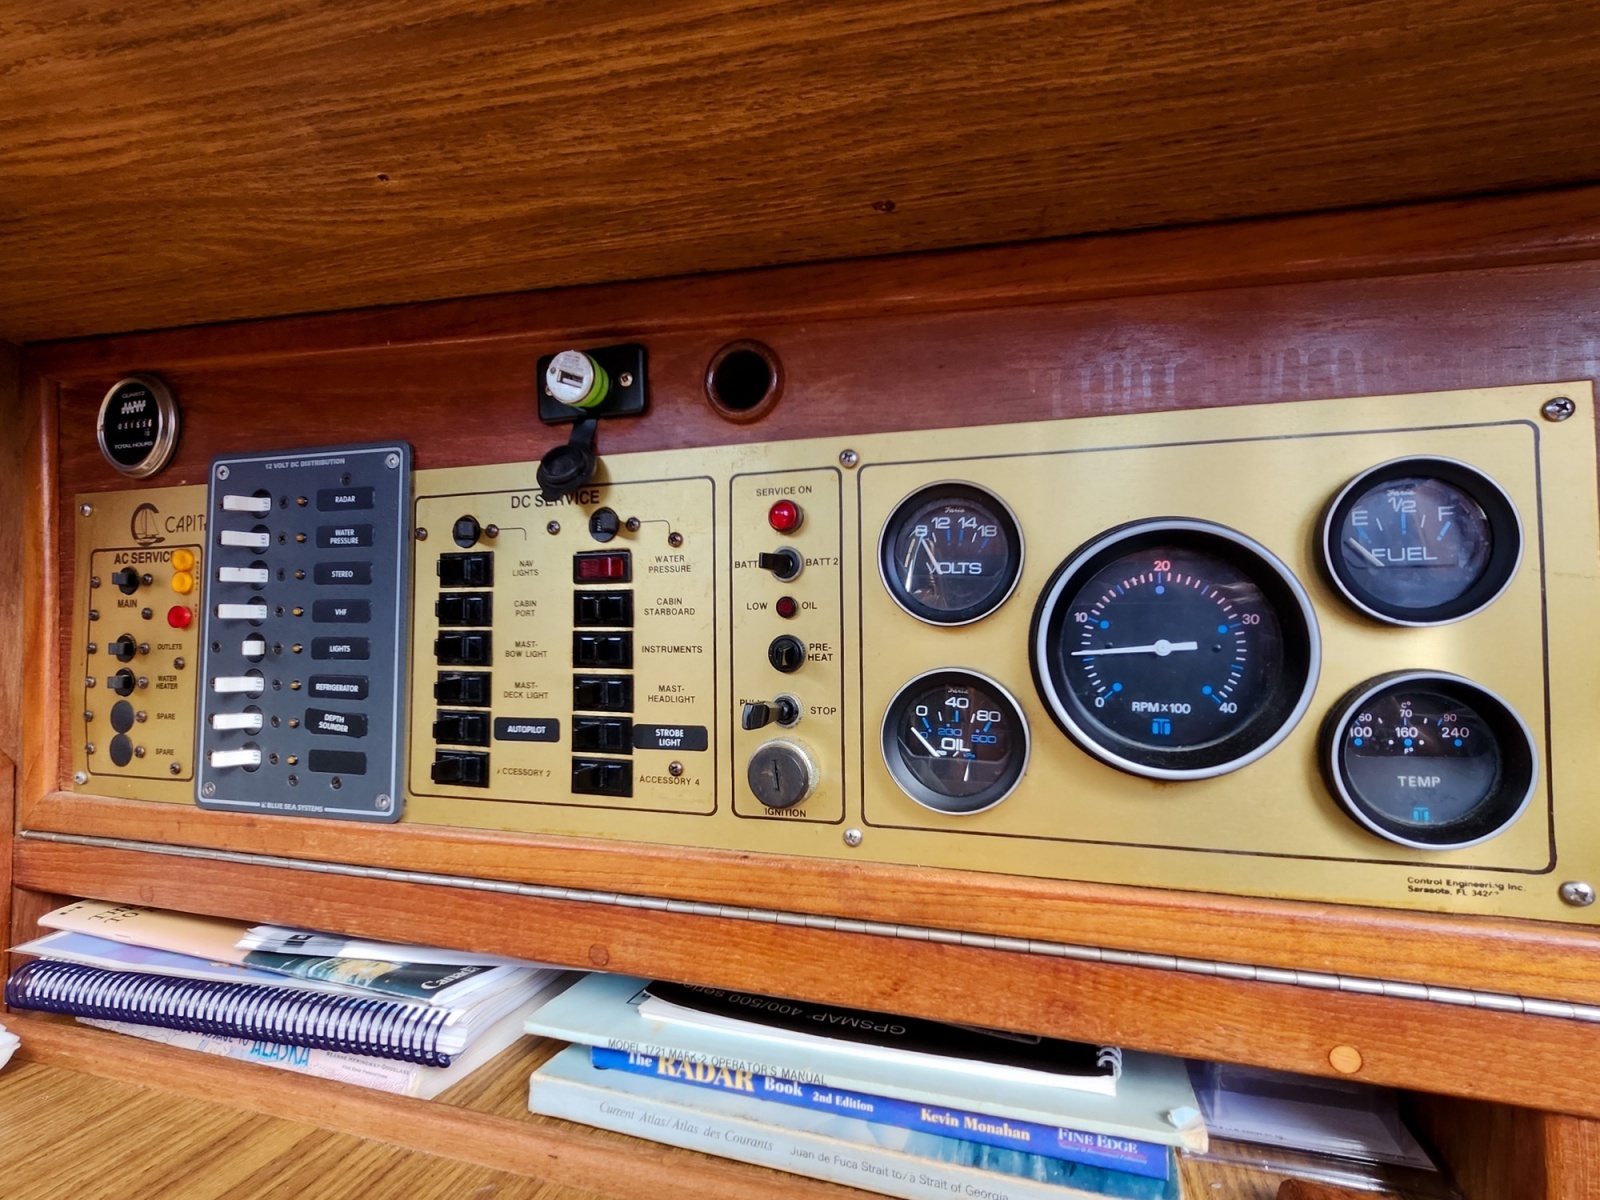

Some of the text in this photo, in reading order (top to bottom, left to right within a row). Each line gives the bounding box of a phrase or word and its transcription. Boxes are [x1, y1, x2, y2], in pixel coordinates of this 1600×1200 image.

[300, 458, 345, 467] DISTRIBUTION
[756, 485, 812, 497] SERVICE ON
[335, 495, 356, 503] RADAR
[511, 495, 531, 508] DC
[1351, 510, 1369, 526] E
[1438, 506, 1455, 521] F
[165, 514, 207, 533] CAPIT
[931, 517, 951, 529] 12
[957, 516, 978, 529] 14
[915, 525, 929, 537] 8
[977, 525, 998, 537] 18
[114, 551, 174, 564] AC SERVIC
[655, 555, 685, 564] WATER
[1371, 547, 1438, 562] FUEL
[805, 557, 839, 567] BATT 2
[1153, 560, 1171, 572] 20
[513, 569, 539, 577] LIGHTS
[649, 565, 692, 573] PRESSURE
[926, 562, 982, 575] VOLTS
[331, 570, 354, 578] STEREO
[117, 600, 138, 608] MAIN
[656, 597, 683, 605] CABIN
[746, 602, 768, 610] LOW
[801, 601, 817, 610] OIL
[515, 609, 535, 617] PORT
[644, 608, 696, 616] STARBOARD
[1074, 612, 1088, 623] 10
[1242, 614, 1260, 625] 30
[329, 645, 351, 653] LIGHTS
[641, 645, 703, 654] INSTRUMENTS
[809, 643, 832, 651] PRE-
[505, 650, 548, 658] BOW LIGHT
[807, 653, 833, 662] HEAT
[157, 675, 177, 683] WATER
[156, 682, 178, 690] HEATER
[315, 683, 359, 692] REFRIGERATOR
[658, 685, 685, 693] MAST-
[526, 691, 549, 699] LIGHT
[648, 695, 695, 704] HEADLIGHT
[944, 697, 969, 709] 40
[1094, 698, 1105, 708] 0
[1219, 702, 1238, 714] 40
[810, 706, 837, 716] STOP
[915, 705, 928, 717] 0
[976, 710, 1001, 722] 80
[1400, 709, 1413, 718] 70
[324, 714, 345, 723] DEPTH
[1443, 714, 1457, 722] 90
[318, 721, 349, 732] SOUNDER
[507, 725, 546, 734] AUTOPILOT
[655, 728, 684, 738] STROBE
[937, 727, 963, 737] 200
[1350, 726, 1373, 738] 100
[1395, 727, 1418, 738] 160
[1441, 727, 1470, 738] 240
[658, 738, 681, 747] LIGHT
[971, 734, 997, 744] 500
[941, 737, 971, 752] OIL
[639, 775, 701, 786] ACCESSORY 4
[1397, 776, 1441, 788] TEMP
[284, 803, 297, 811] SEA
[297, 804, 324, 812] SYSTEMS
[764, 807, 807, 818] IGNITION
[1407, 876, 1442, 886] Control
[730, 994, 804, 1017] 400/500
[812, 1012, 906, 1036] GPSMAP
[608, 1038, 639, 1053] MODEL
[669, 1049, 707, 1063] MARK-2
[711, 1056, 778, 1076] OPERATOR'S
[781, 1069, 827, 1085] MANUAL
[628, 1051, 1031, 1141] The RADAR Book 2nd Edition Kevin Monahan
[599, 1101, 635, 1119] Current
[672, 1119, 699, 1134] Atlas
[703, 1126, 721, 1139] des
[724, 1130, 774, 1151] Courants
[1058, 1127, 1138, 1154] FINE EDGE
[790, 1147, 815, 1160] Juan
[818, 1153, 830, 1163] de
[833, 1155, 858, 1170] Fuca
[861, 1162, 889, 1177] Strait
[919, 1175, 948, 1190] Strait
[950, 1183, 962, 1194] of
[965, 1184, 1009, 1200] Georgia
